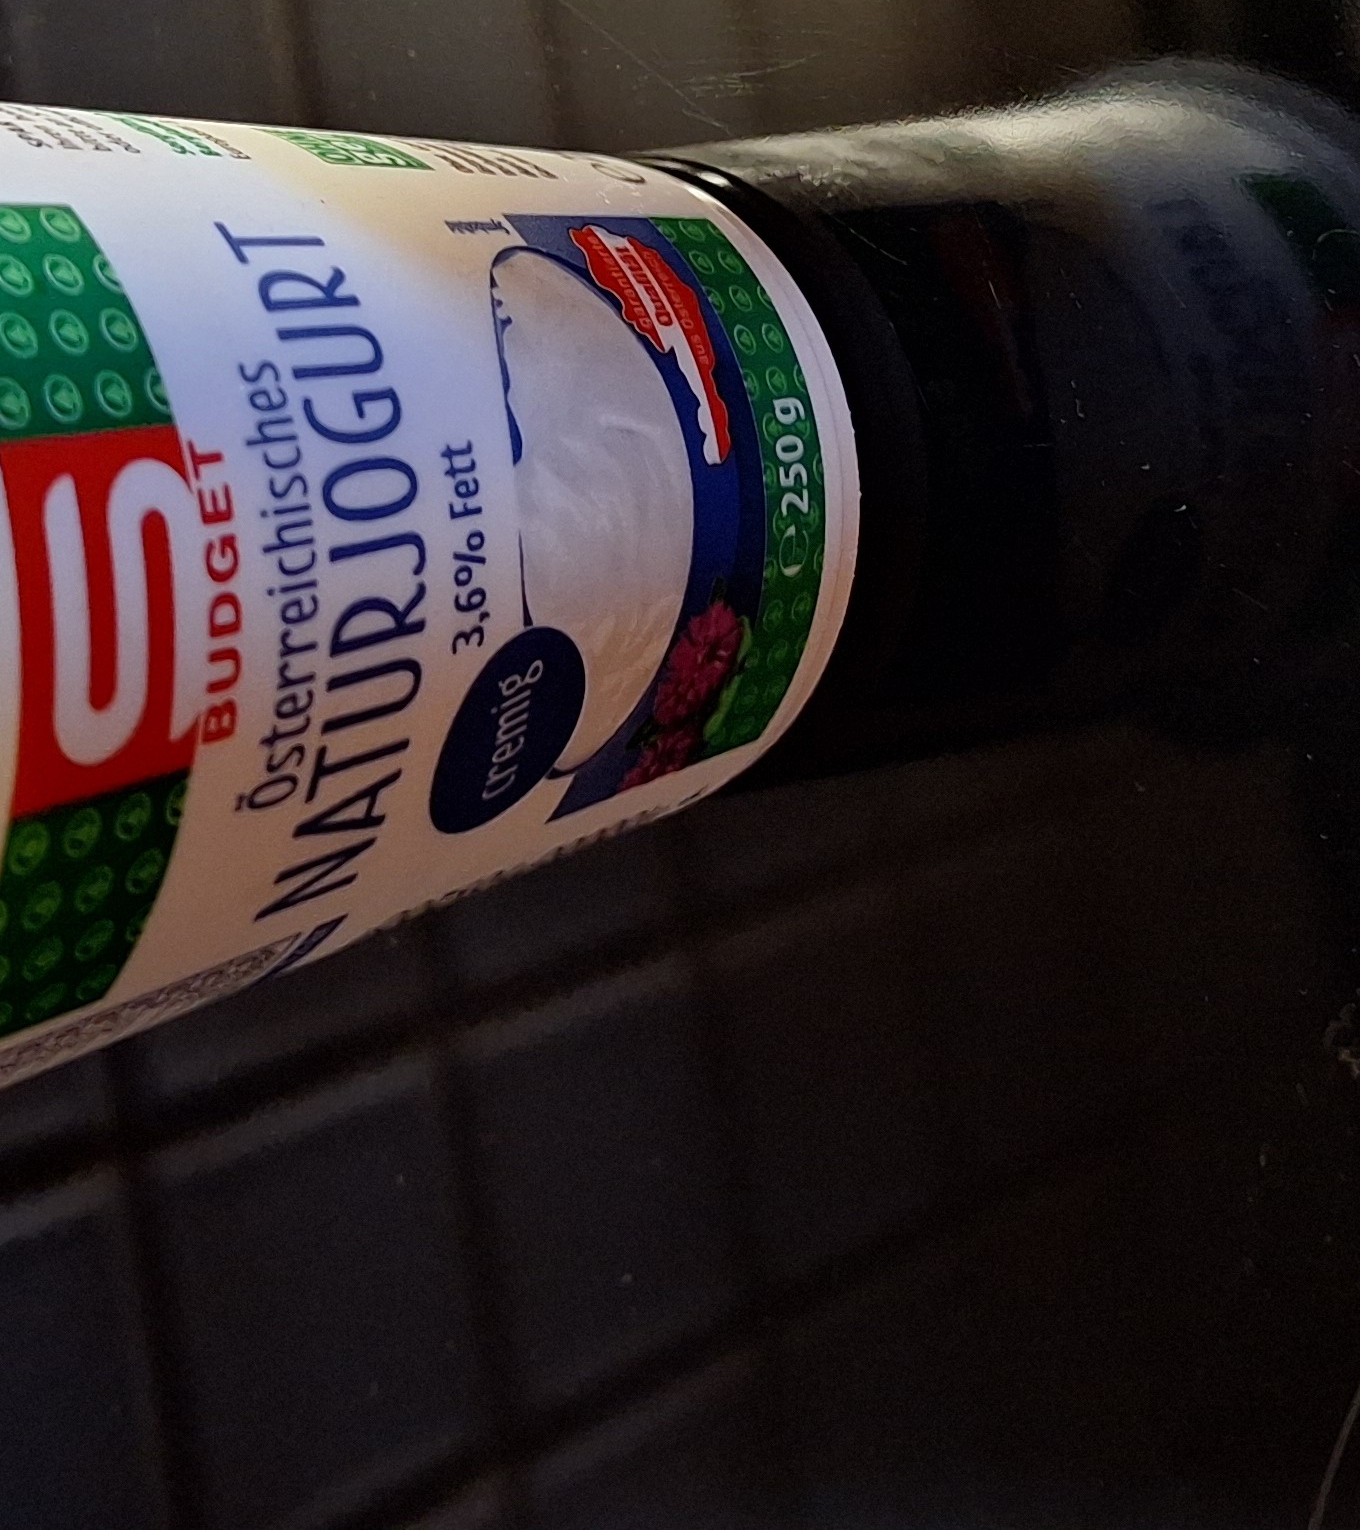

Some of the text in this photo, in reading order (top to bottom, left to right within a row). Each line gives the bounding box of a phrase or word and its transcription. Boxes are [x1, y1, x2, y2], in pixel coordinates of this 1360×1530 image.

[586, 234, 654, 329] garantierte
[642, 251, 710, 366] aus Österreich
[772, 396, 805, 425] g
[774, 433, 810, 516] 250
[187, 439, 243, 745] BUDGET
[212, 221, 427, 922] NATURJOGURT
[235, 359, 319, 812] Österreichisches
[439, 439, 491, 655] 3,6% Fett
[481, 659, 544, 802] cremig
